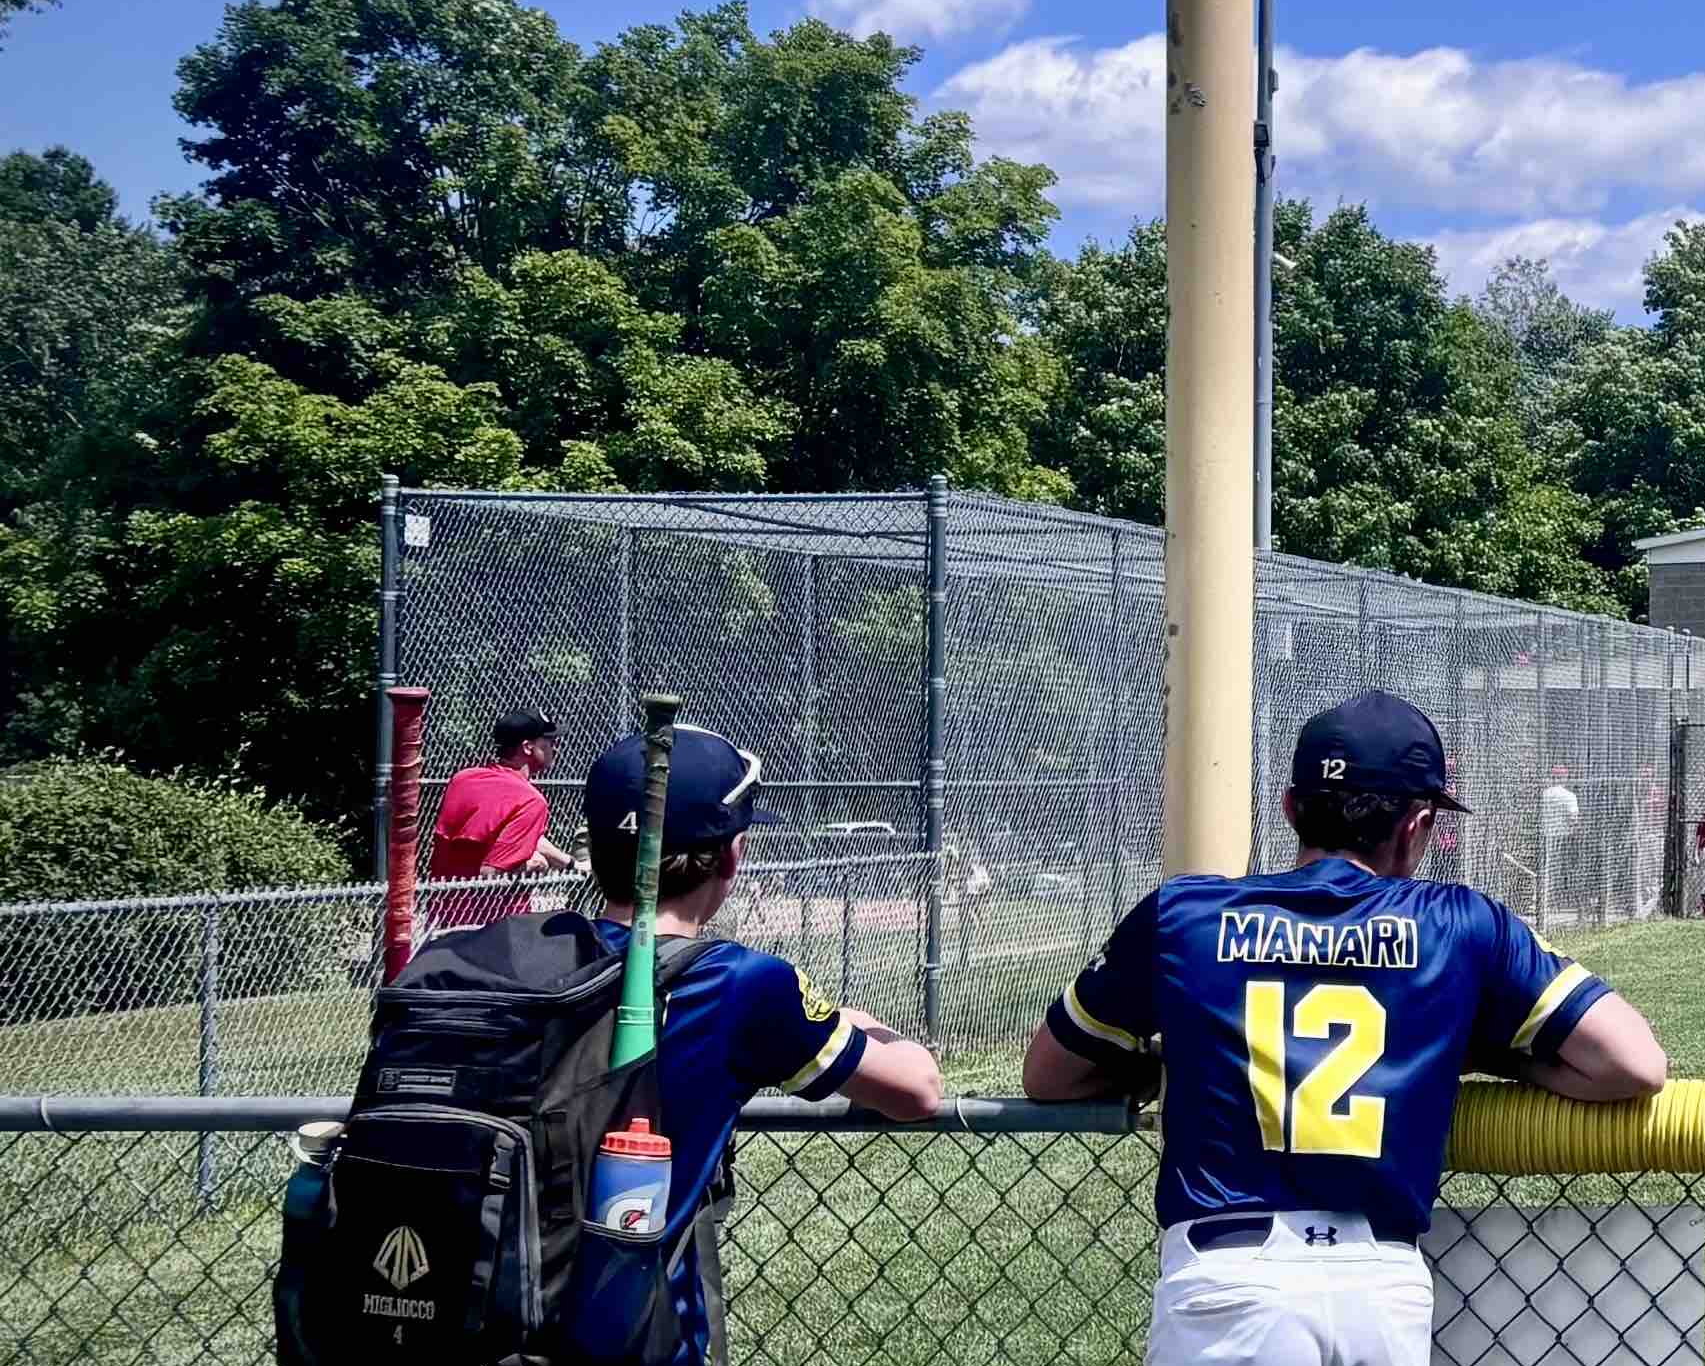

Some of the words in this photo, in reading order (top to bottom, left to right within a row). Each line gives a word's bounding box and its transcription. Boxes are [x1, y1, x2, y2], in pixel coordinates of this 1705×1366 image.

[1320, 758, 1346, 780] 12
[617, 810, 640, 835] 4
[1218, 911, 1420, 969] MANARI
[1243, 980, 1387, 1159] 12
[361, 1292, 436, 1322] MIGLIOCCO
[390, 1324, 403, 1346] 4
